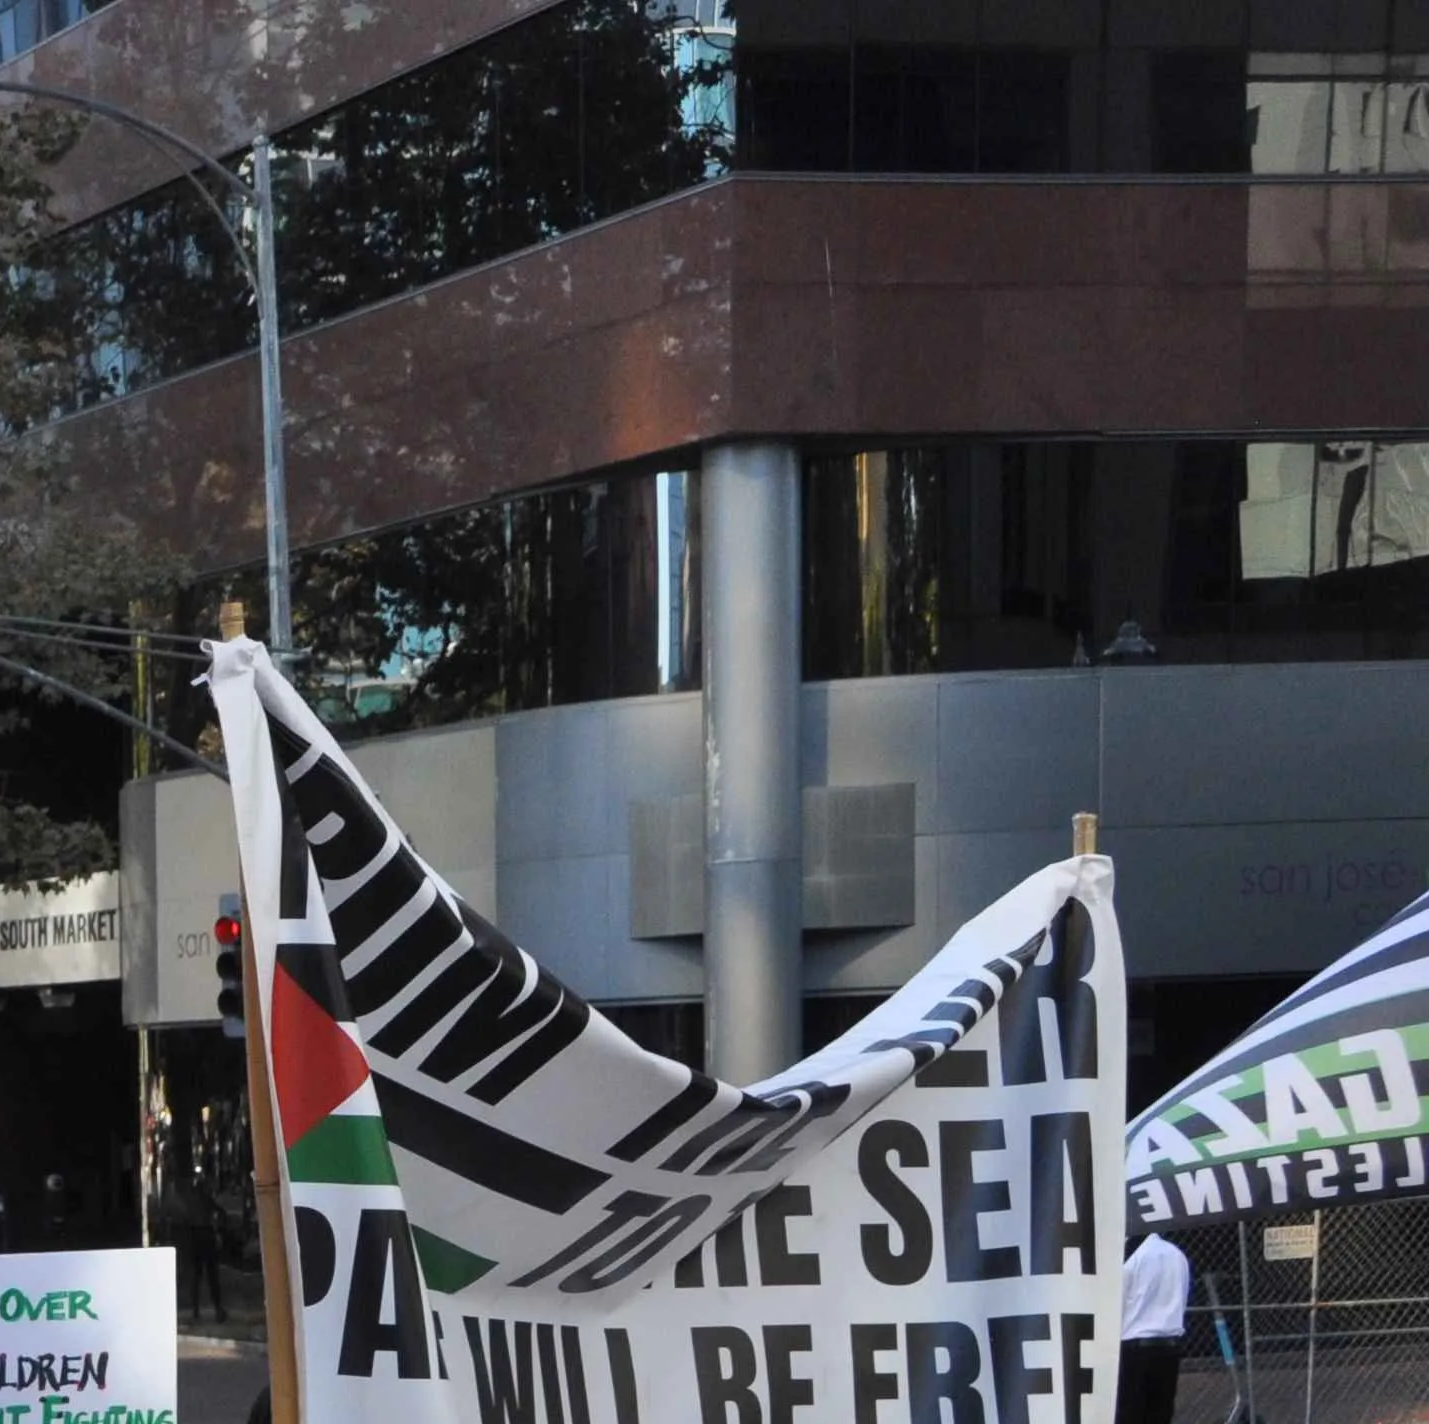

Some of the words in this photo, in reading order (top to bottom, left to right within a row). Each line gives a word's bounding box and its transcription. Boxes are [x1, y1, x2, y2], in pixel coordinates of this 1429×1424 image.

[0, 914, 49, 951] SOUTH
[52, 908, 118, 946] MARKET
[177, 929, 211, 959] san
[857, 1109, 1098, 1287] SEA
